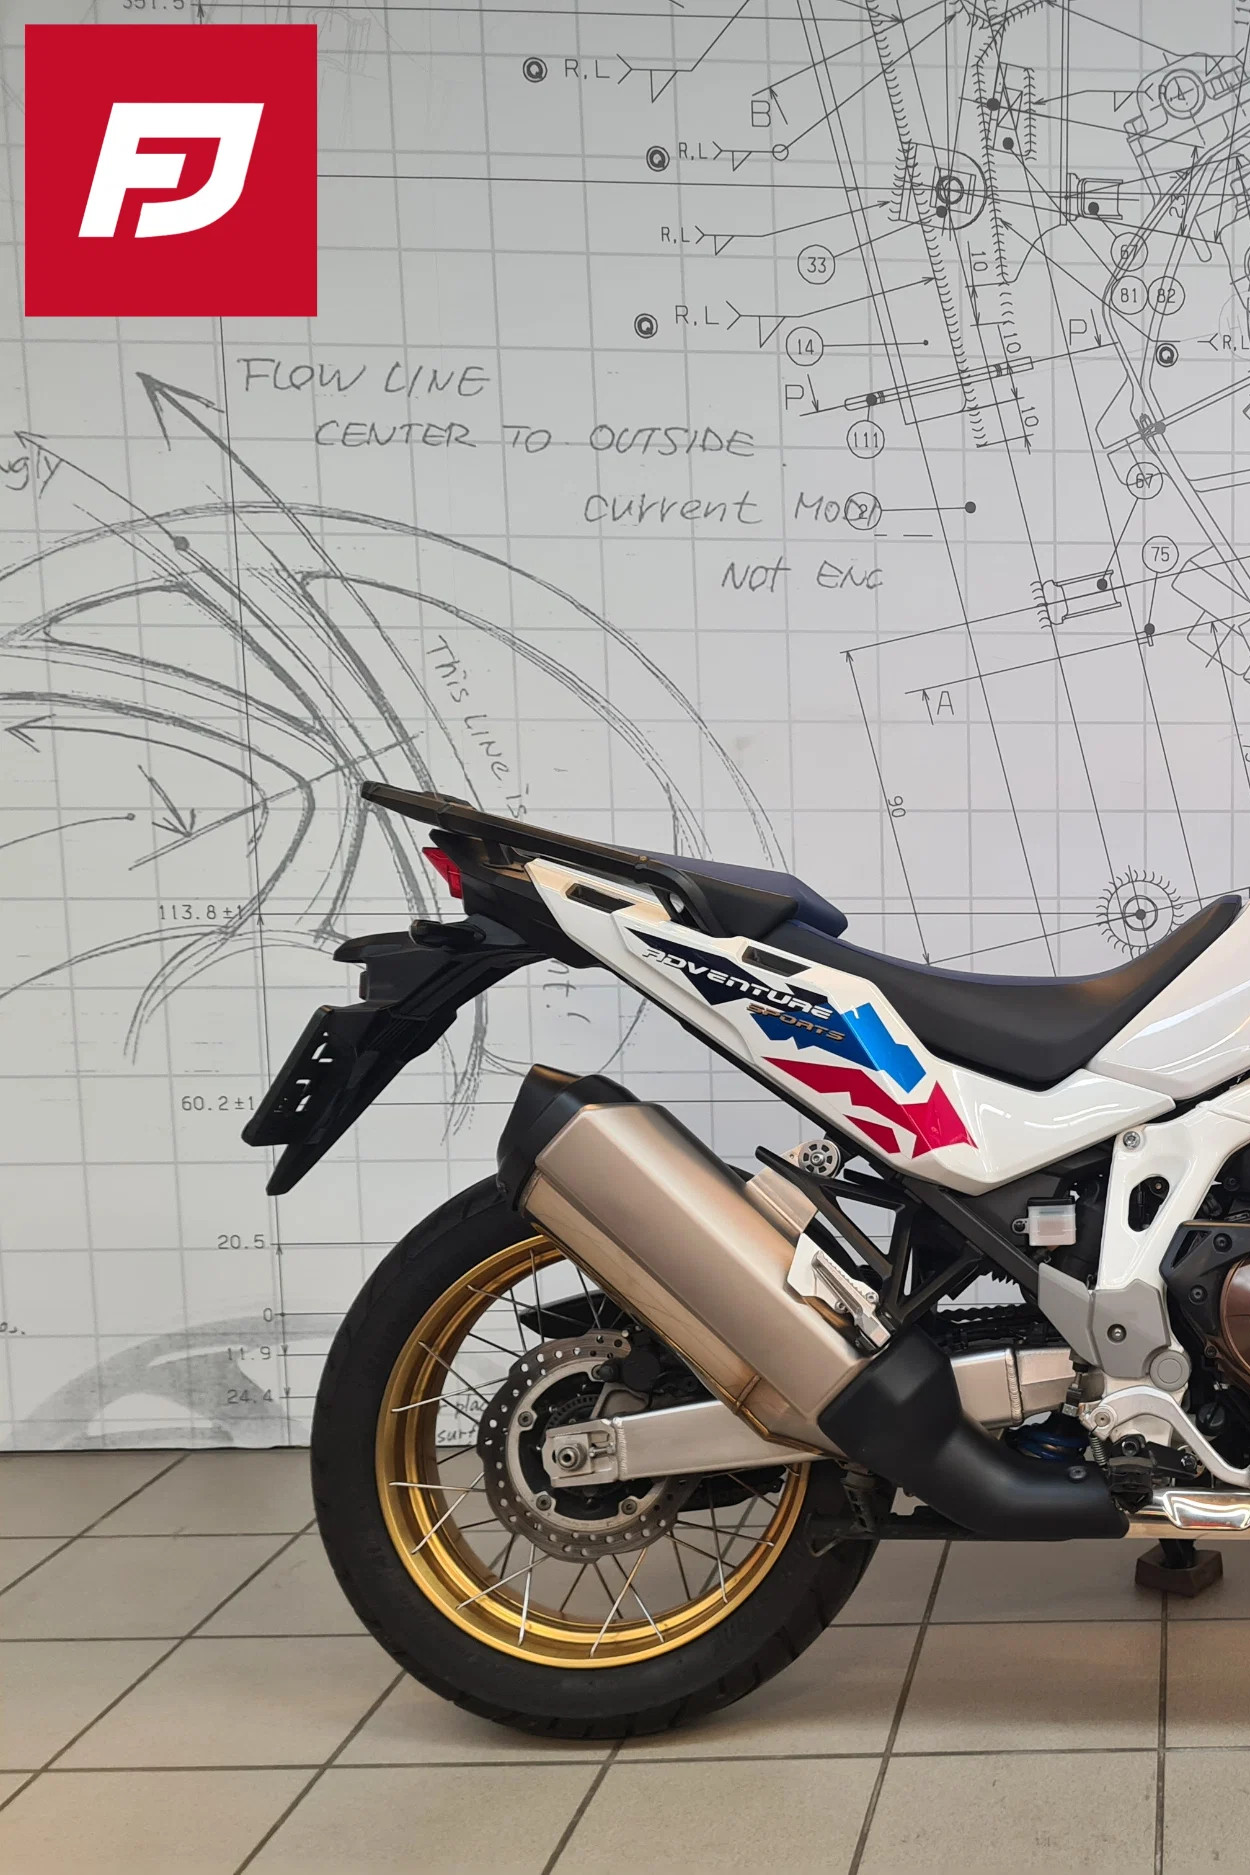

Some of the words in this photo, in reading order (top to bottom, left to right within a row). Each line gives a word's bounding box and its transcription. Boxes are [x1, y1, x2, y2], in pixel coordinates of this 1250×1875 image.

[751, 100, 771, 127] B
[806, 256, 827, 274] 33
[971, 250, 988, 272] 10
[1120, 287, 1137, 303] 81
[1156, 287, 1176, 304] 82
[1003, 332, 1022, 354] 10
[1069, 318, 1088, 346] P
[796, 338, 815, 355] 14
[237, 357, 366, 391] FLOW
[385, 364, 491, 398] LINE
[784, 383, 805, 410] P
[1021, 405, 1040, 428] 10
[315, 419, 477, 447] CENTER
[502, 424, 551, 452] TO
[590, 423, 756, 456] OUTSIDE
[1150, 546, 1170, 562] 75
[936, 690, 955, 715] A
[888, 795, 907, 818] 90
[642, 948, 834, 1021] ADVENTURE
[746, 1002, 846, 1042] SPORTS
[217, 1233, 265, 1250] 20.5
[227, 1345, 272, 1361] 11.9
[226, 1388, 274, 1405] 24.4
